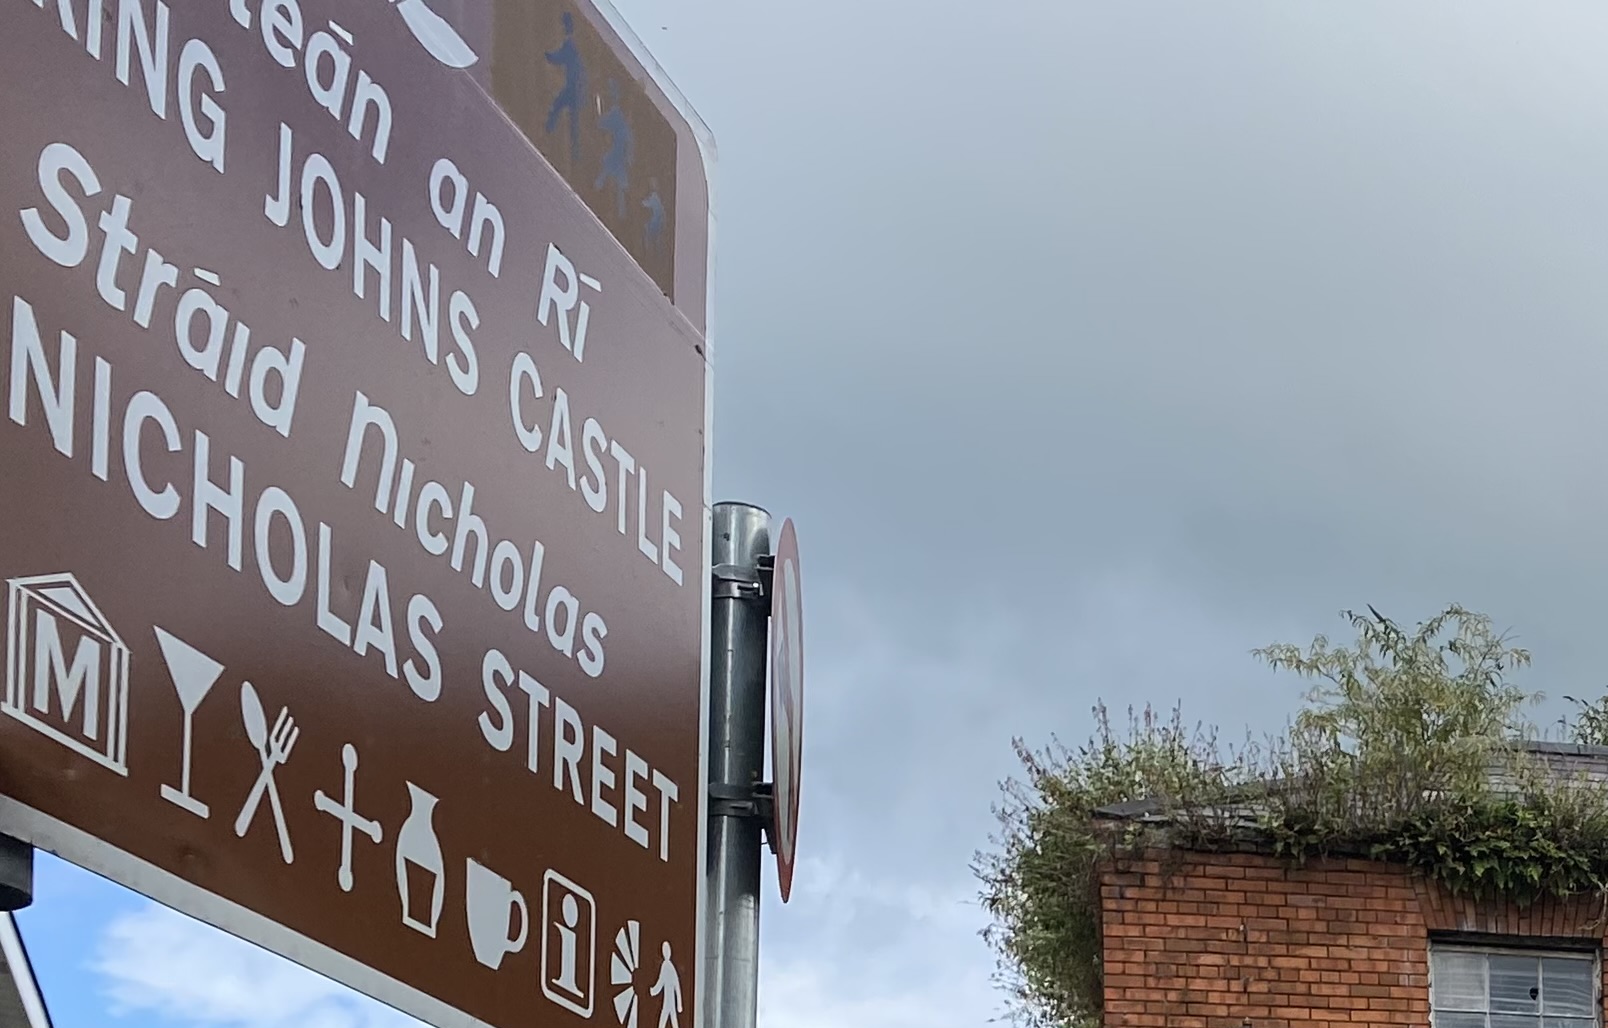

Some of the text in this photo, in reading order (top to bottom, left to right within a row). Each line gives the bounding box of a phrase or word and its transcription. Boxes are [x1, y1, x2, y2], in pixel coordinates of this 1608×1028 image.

[30, 0, 683, 587] ING JOHNS CASTLE
[430, 159, 505, 279] an
[538, 243, 603, 363] Rí
[9, 296, 679, 863] NICHOLAS STREET
